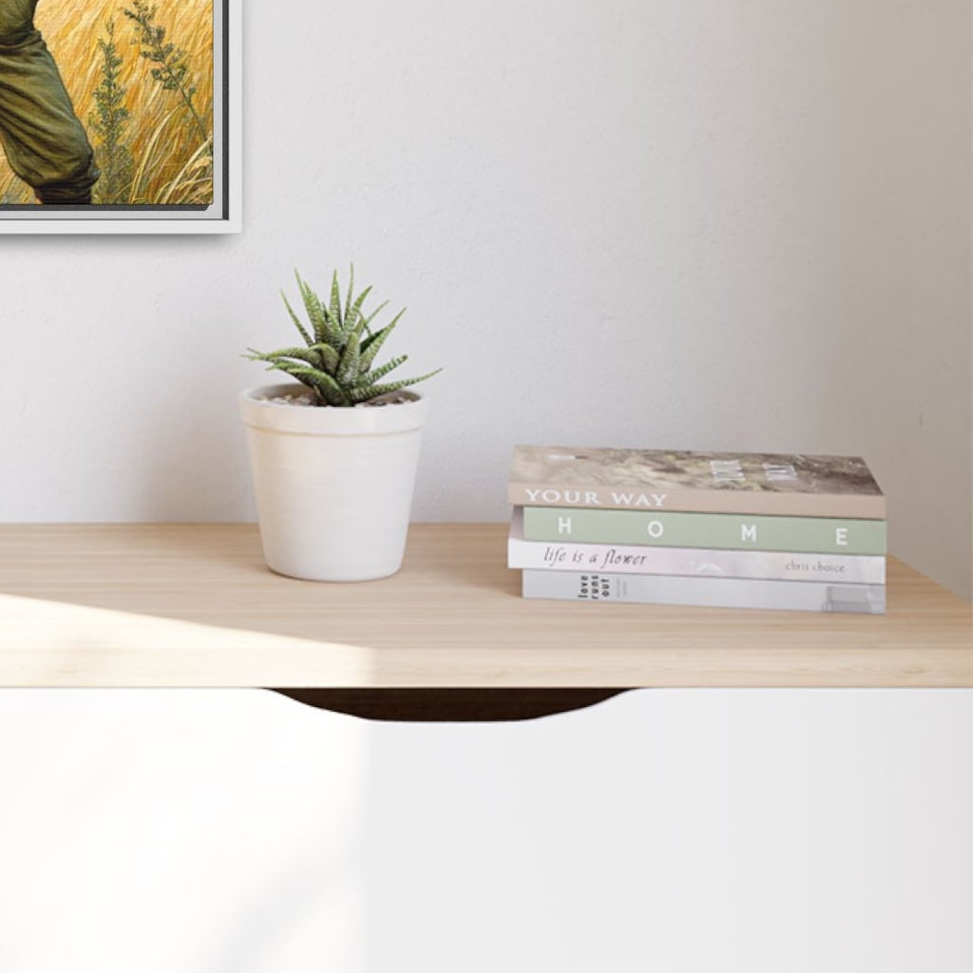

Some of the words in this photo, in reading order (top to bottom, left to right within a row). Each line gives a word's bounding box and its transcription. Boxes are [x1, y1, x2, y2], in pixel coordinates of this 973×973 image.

[525, 489, 601, 505] YOUR
[612, 492, 668, 507] WAY
[543, 546, 567, 567] life
[572, 548, 585, 563] is
[589, 553, 598, 564] a
[603, 548, 647, 569] flower
[785, 559, 809, 572] chris
[812, 560, 845, 573] choice
[578, 575, 589, 598] love
[591, 575, 599, 599] runs
[600, 578, 610, 597] out
